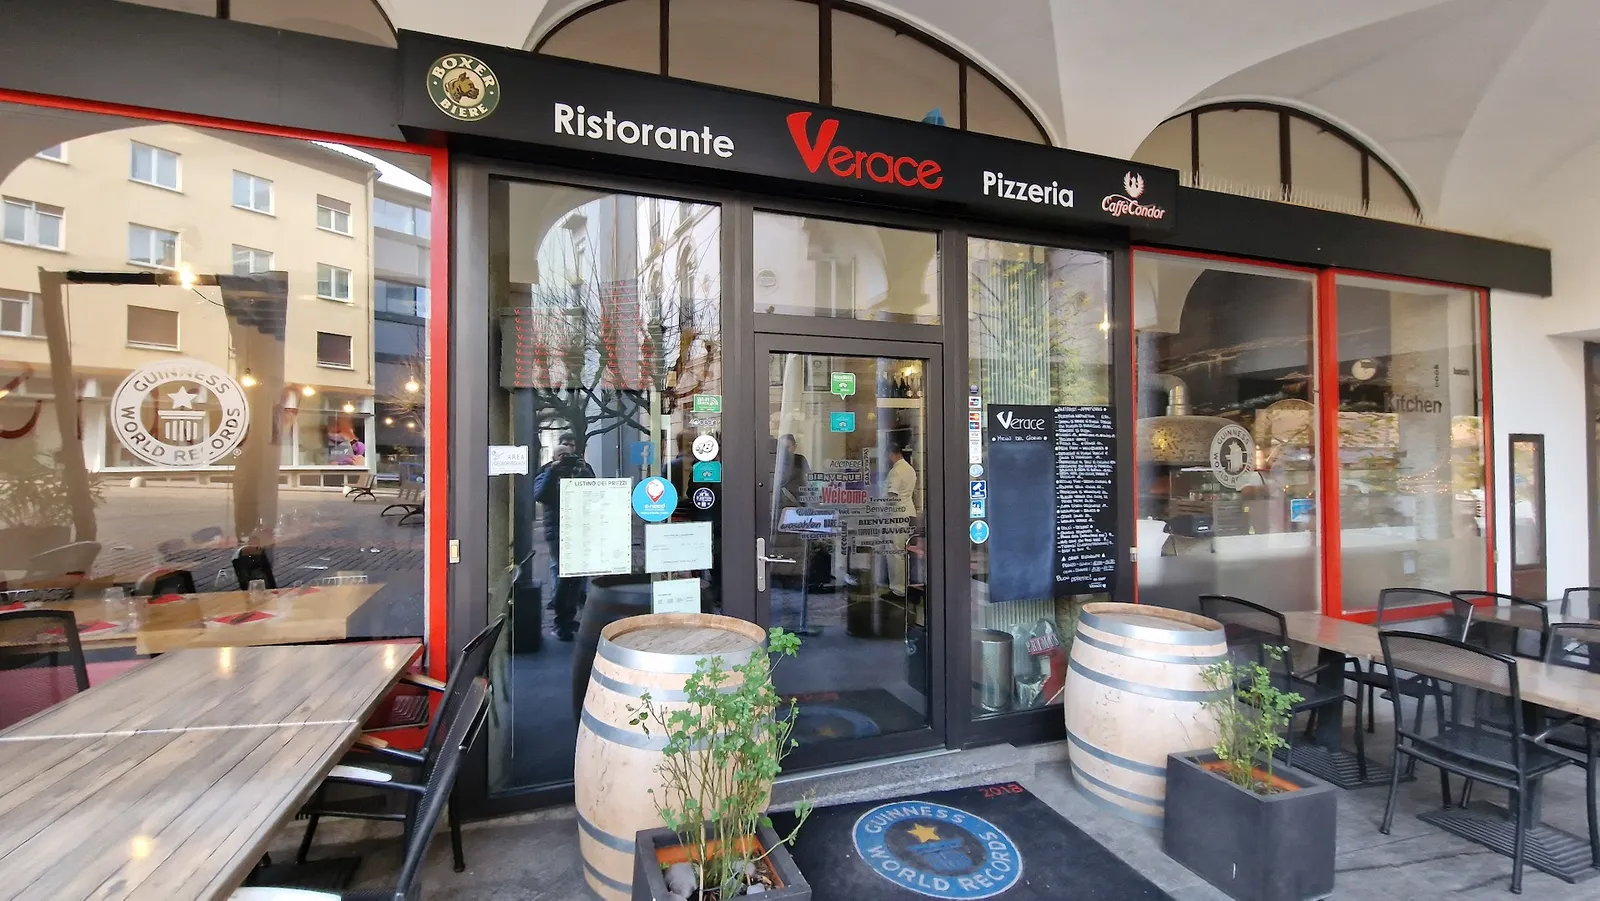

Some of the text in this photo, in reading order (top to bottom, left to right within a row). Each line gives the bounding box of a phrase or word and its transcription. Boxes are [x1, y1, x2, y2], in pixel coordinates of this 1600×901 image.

[432, 56, 495, 88] BOXER
[439, 98, 489, 117] BIERE
[554, 102, 735, 158] Ristorante
[786, 111, 944, 190] Verace
[983, 170, 1074, 208] Pizzeria
[133, 367, 230, 394] GUINNESS
[1384, 392, 1443, 413] Kitchen
[996, 410, 1046, 430] Verace
[121, 405, 166, 457] WORLD
[1217, 430, 1250, 445] GUINNESS
[808, 473, 862, 482] BIENVENUE
[822, 487, 867, 504] Welcome
[866, 505, 906, 513] Benvenuto
[858, 517, 910, 526] BIENVENIDO
[978, 783, 1025, 799] 2018
[865, 806, 967, 834] GUINNESS
[867, 831, 1012, 892] WORLD RECORDS
